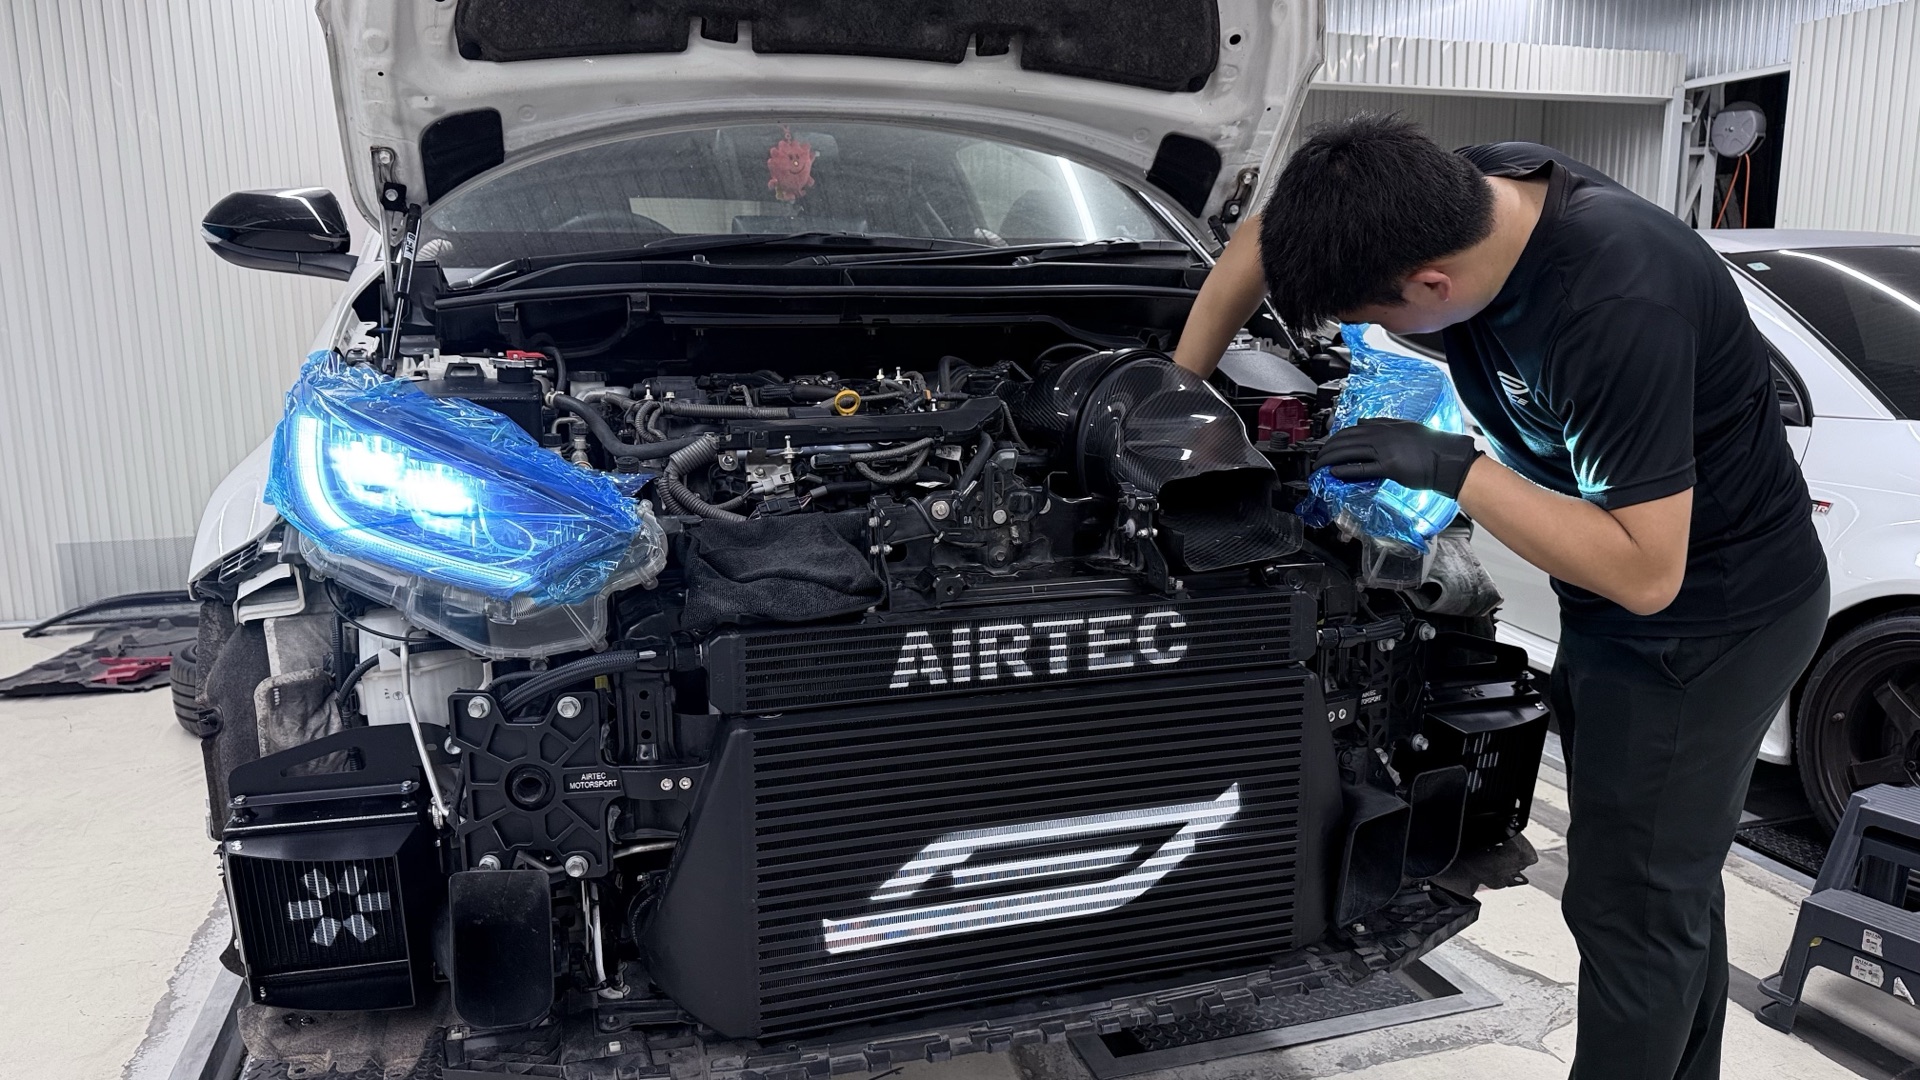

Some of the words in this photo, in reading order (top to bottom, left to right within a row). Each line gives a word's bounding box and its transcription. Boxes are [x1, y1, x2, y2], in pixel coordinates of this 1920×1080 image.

[889, 610, 1188, 690] AIRTEC
[580, 771, 607, 781] AIRTEC
[569, 779, 618, 790] MOTORSPORT
